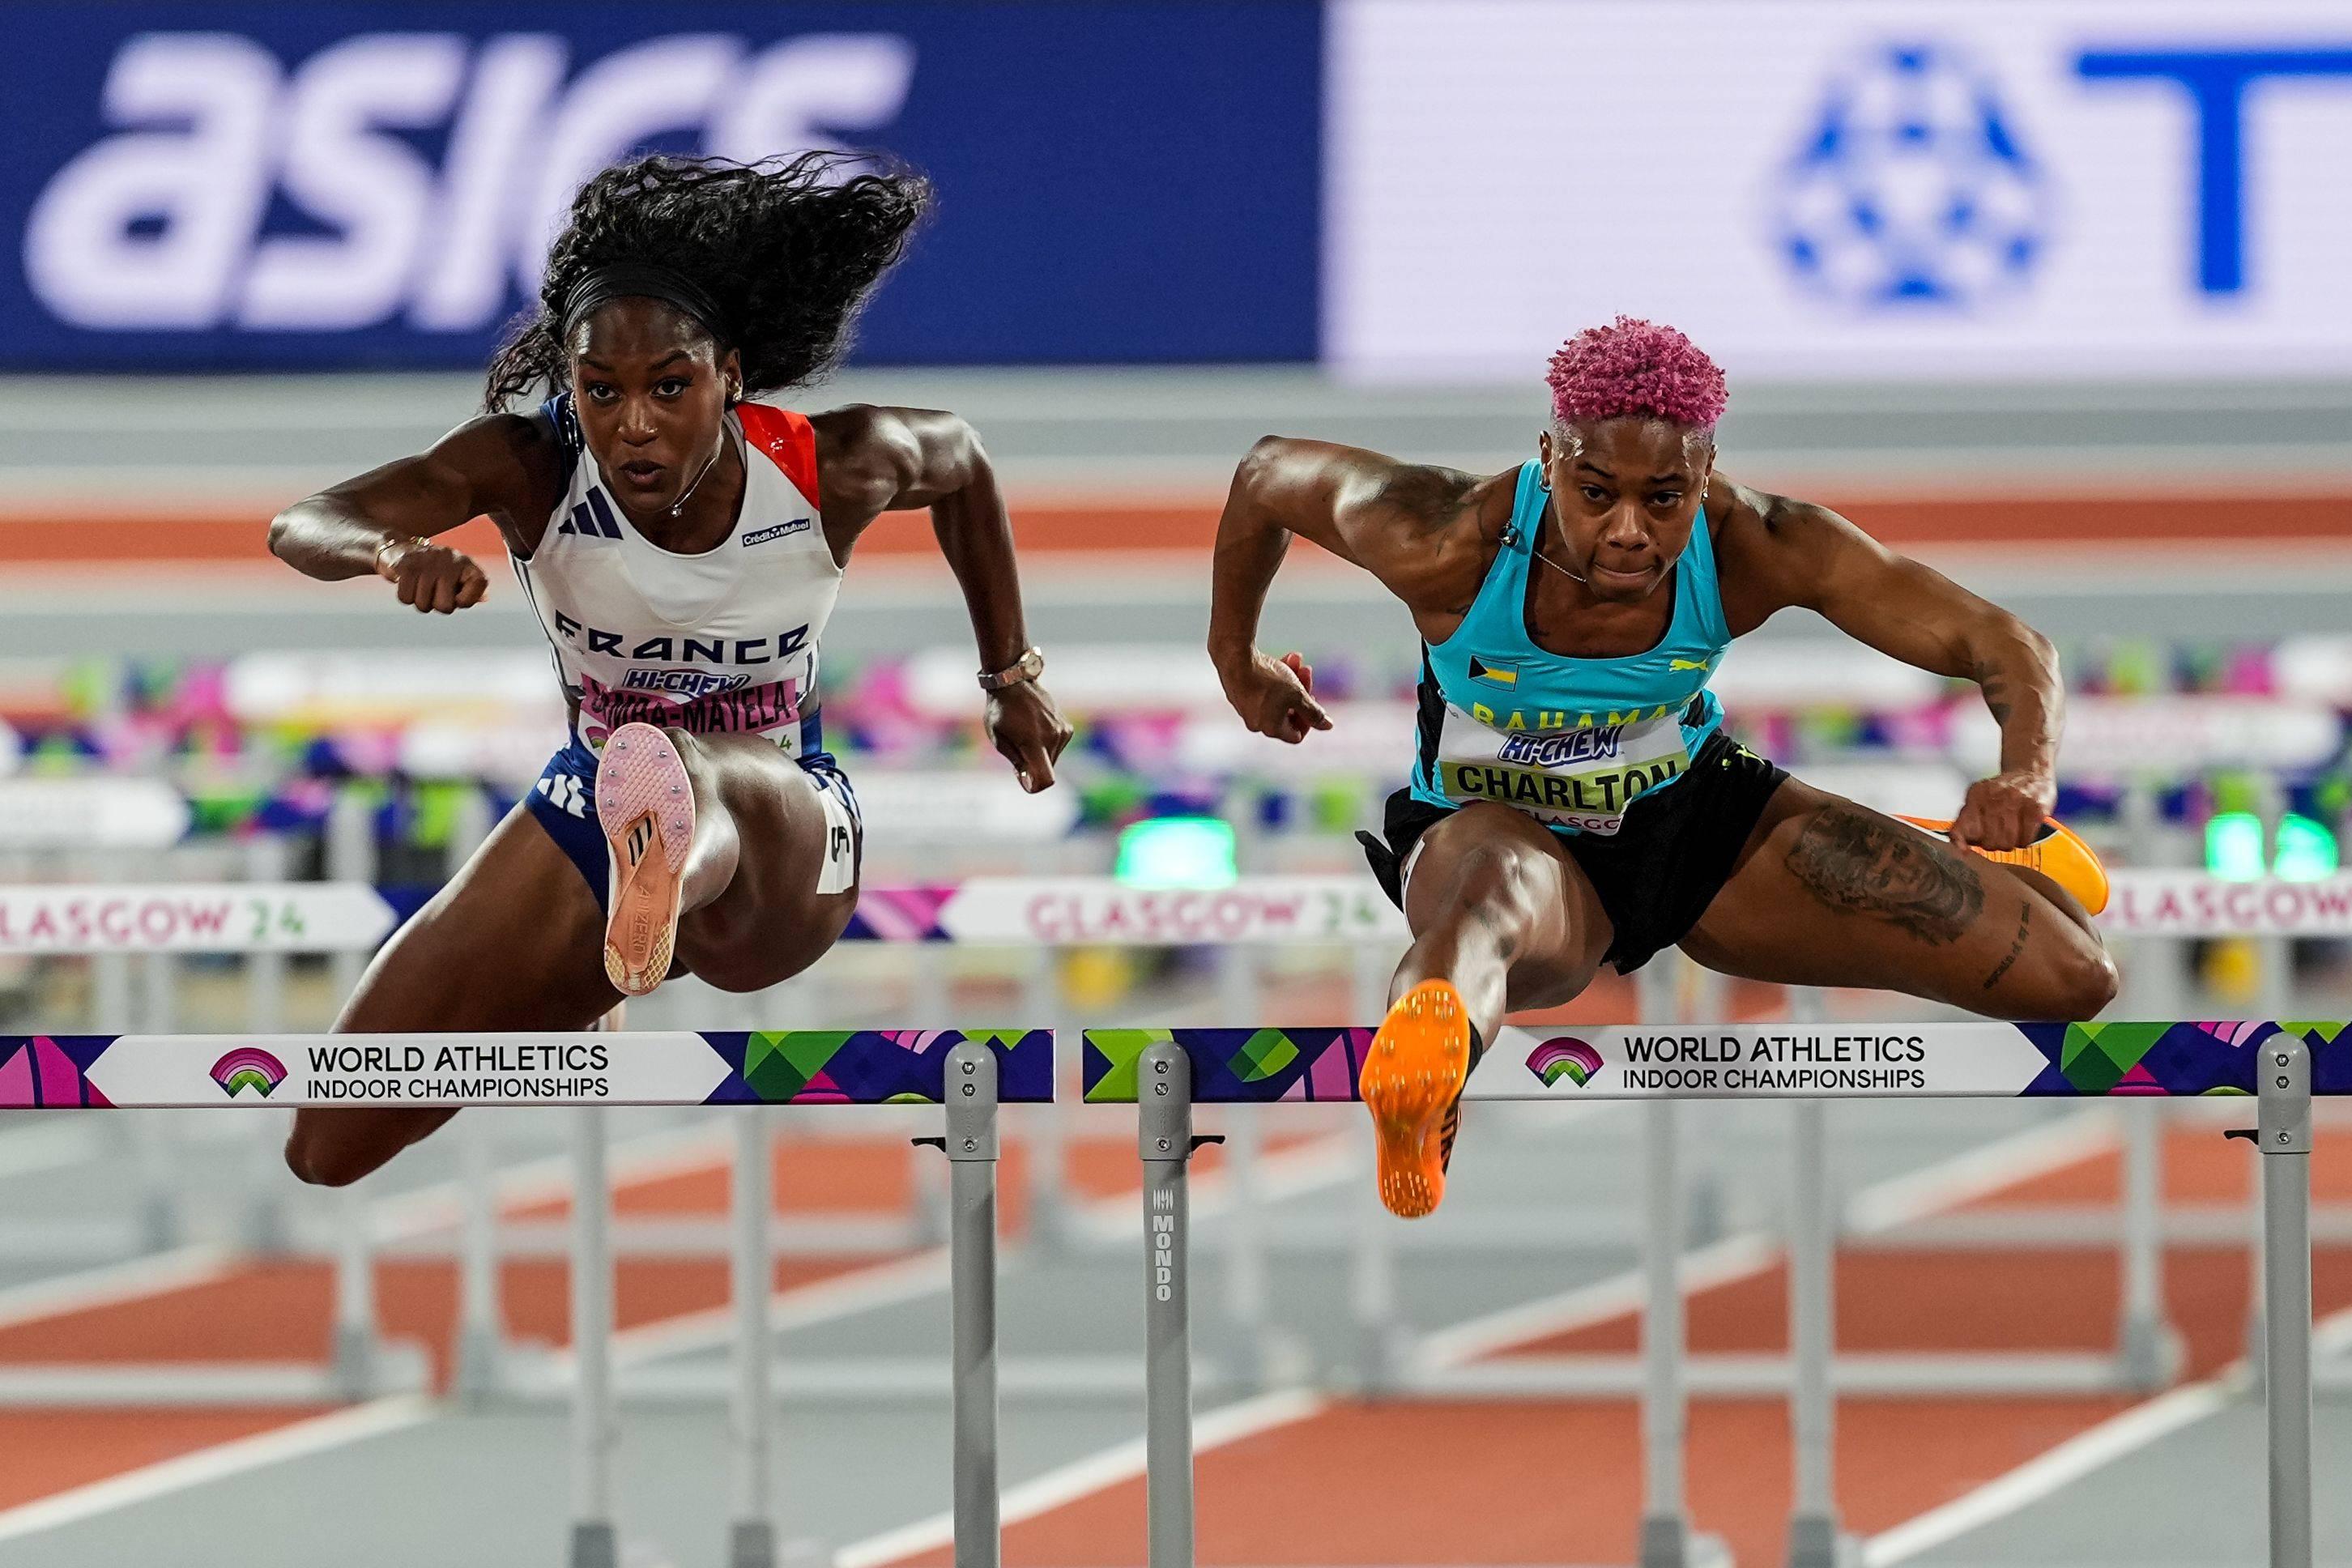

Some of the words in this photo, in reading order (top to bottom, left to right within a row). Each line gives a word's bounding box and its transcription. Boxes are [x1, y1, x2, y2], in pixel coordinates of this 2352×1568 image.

[780, 521, 809, 535] Mutuel
[555, 609, 809, 665] FRANCE
[623, 669, 752, 700] HI-CHEW
[1498, 725, 1623, 767] HI-CHEW
[1457, 760, 1677, 812] CHARLTON
[250, 897, 305, 941] 24
[1026, 893, 1302, 938] GLASGOW
[308, 1046, 424, 1073] WORLD
[433, 1045, 608, 1072] ATHLETICS
[1623, 1037, 1741, 1063] WORLD
[1749, 1036, 1925, 1063] ATHLETICS
[308, 1079, 402, 1099] INDOOR
[408, 1077, 608, 1098] CHAMPIONSHIPS
[1623, 1070, 1718, 1089] INDOOR
[1724, 1068, 1925, 1089] CHAMPIONSHIPS
[1153, 1215, 1174, 1302] MONDO
